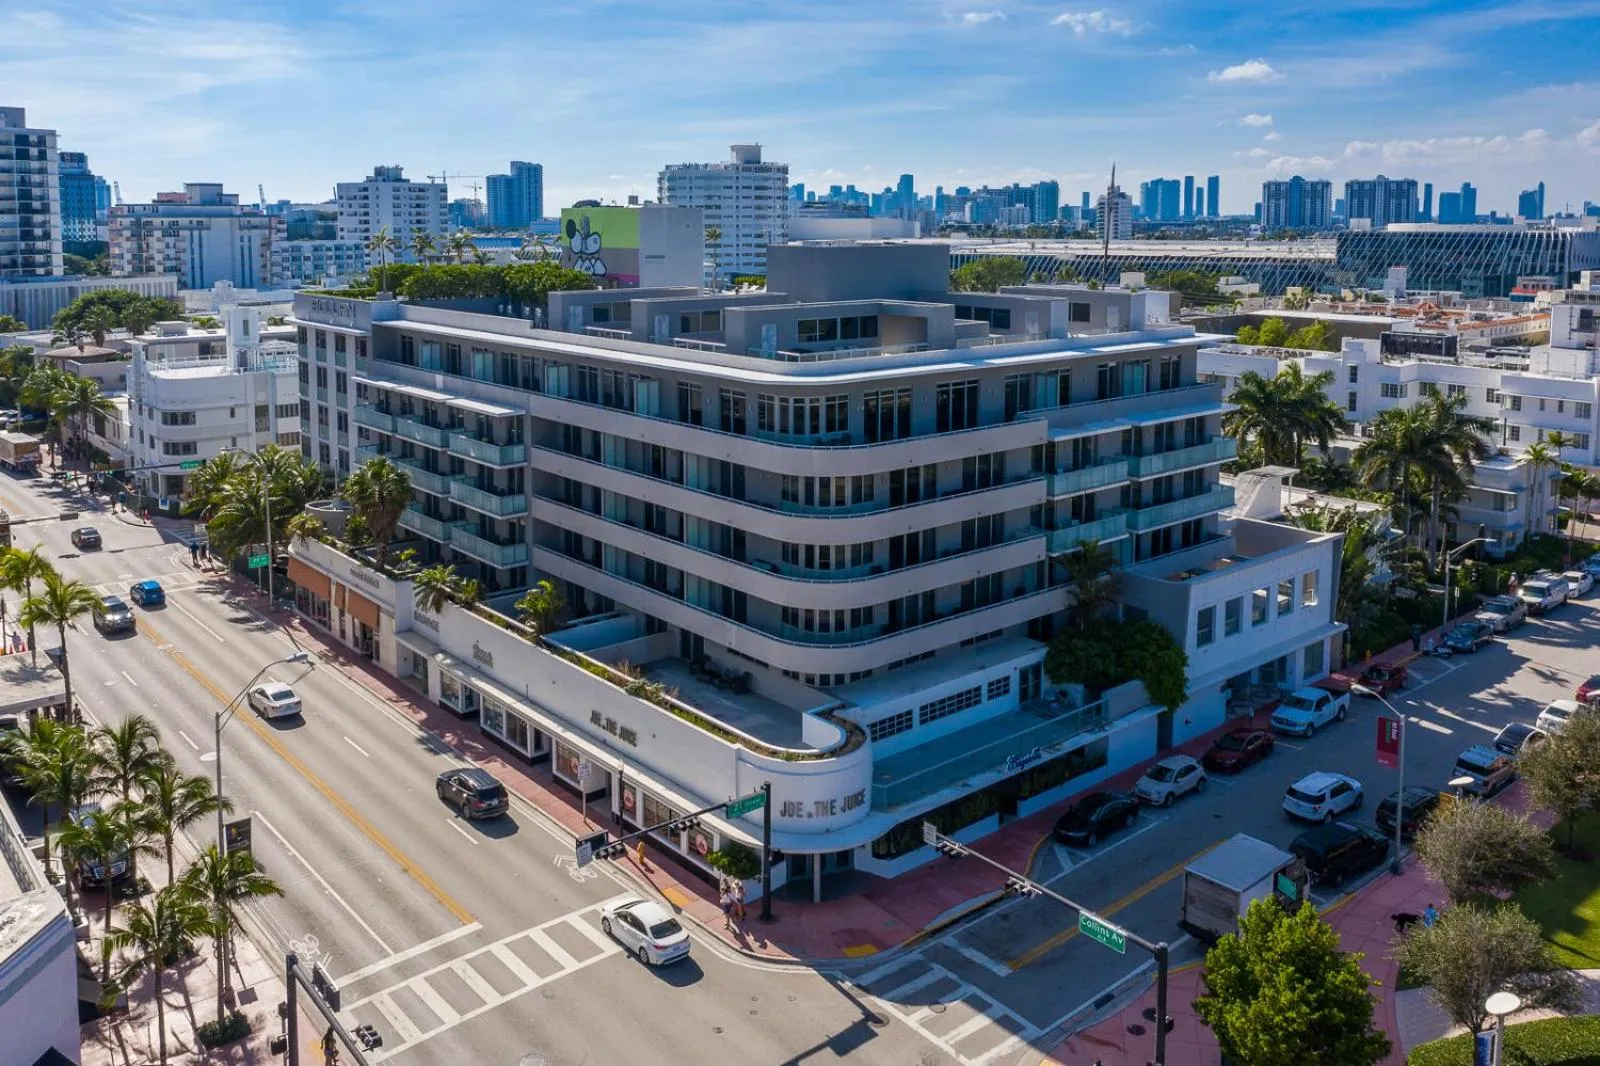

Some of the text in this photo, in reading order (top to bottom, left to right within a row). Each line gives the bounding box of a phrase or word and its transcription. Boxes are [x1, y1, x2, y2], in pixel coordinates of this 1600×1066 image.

[780, 800, 804, 818] JOE
[813, 799, 837, 817] THE
[840, 787, 867, 813] JUICE
[1081, 915, 1123, 944] Collins Av
